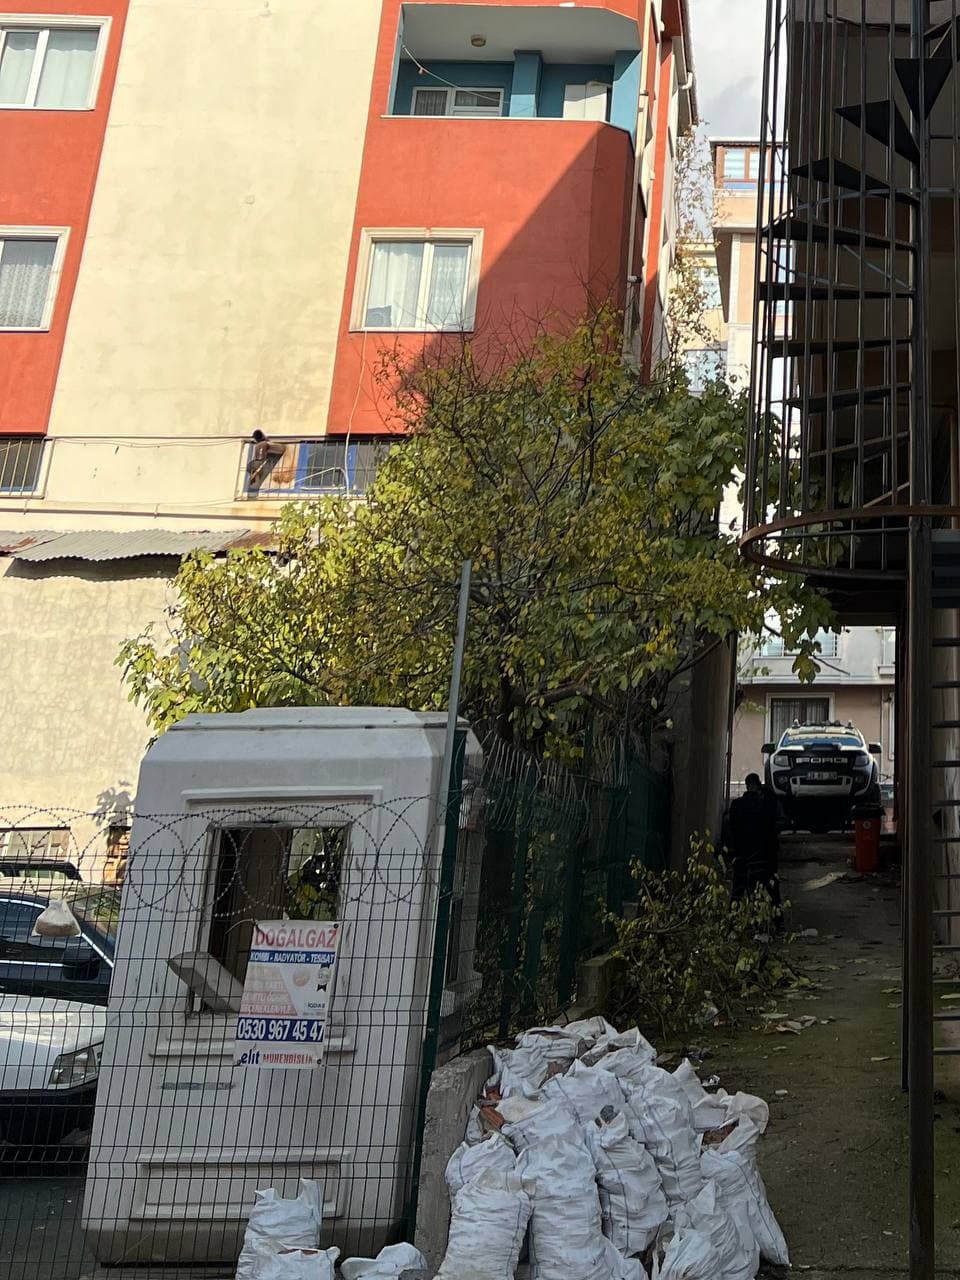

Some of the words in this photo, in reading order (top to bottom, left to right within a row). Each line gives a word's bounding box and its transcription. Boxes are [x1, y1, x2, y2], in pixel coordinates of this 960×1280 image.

[238, 1019, 266, 1039] 0530
[268, 1020, 291, 1040] 967
[292, 1021, 308, 1041] 45
[310, 1021, 325, 1041] 47
